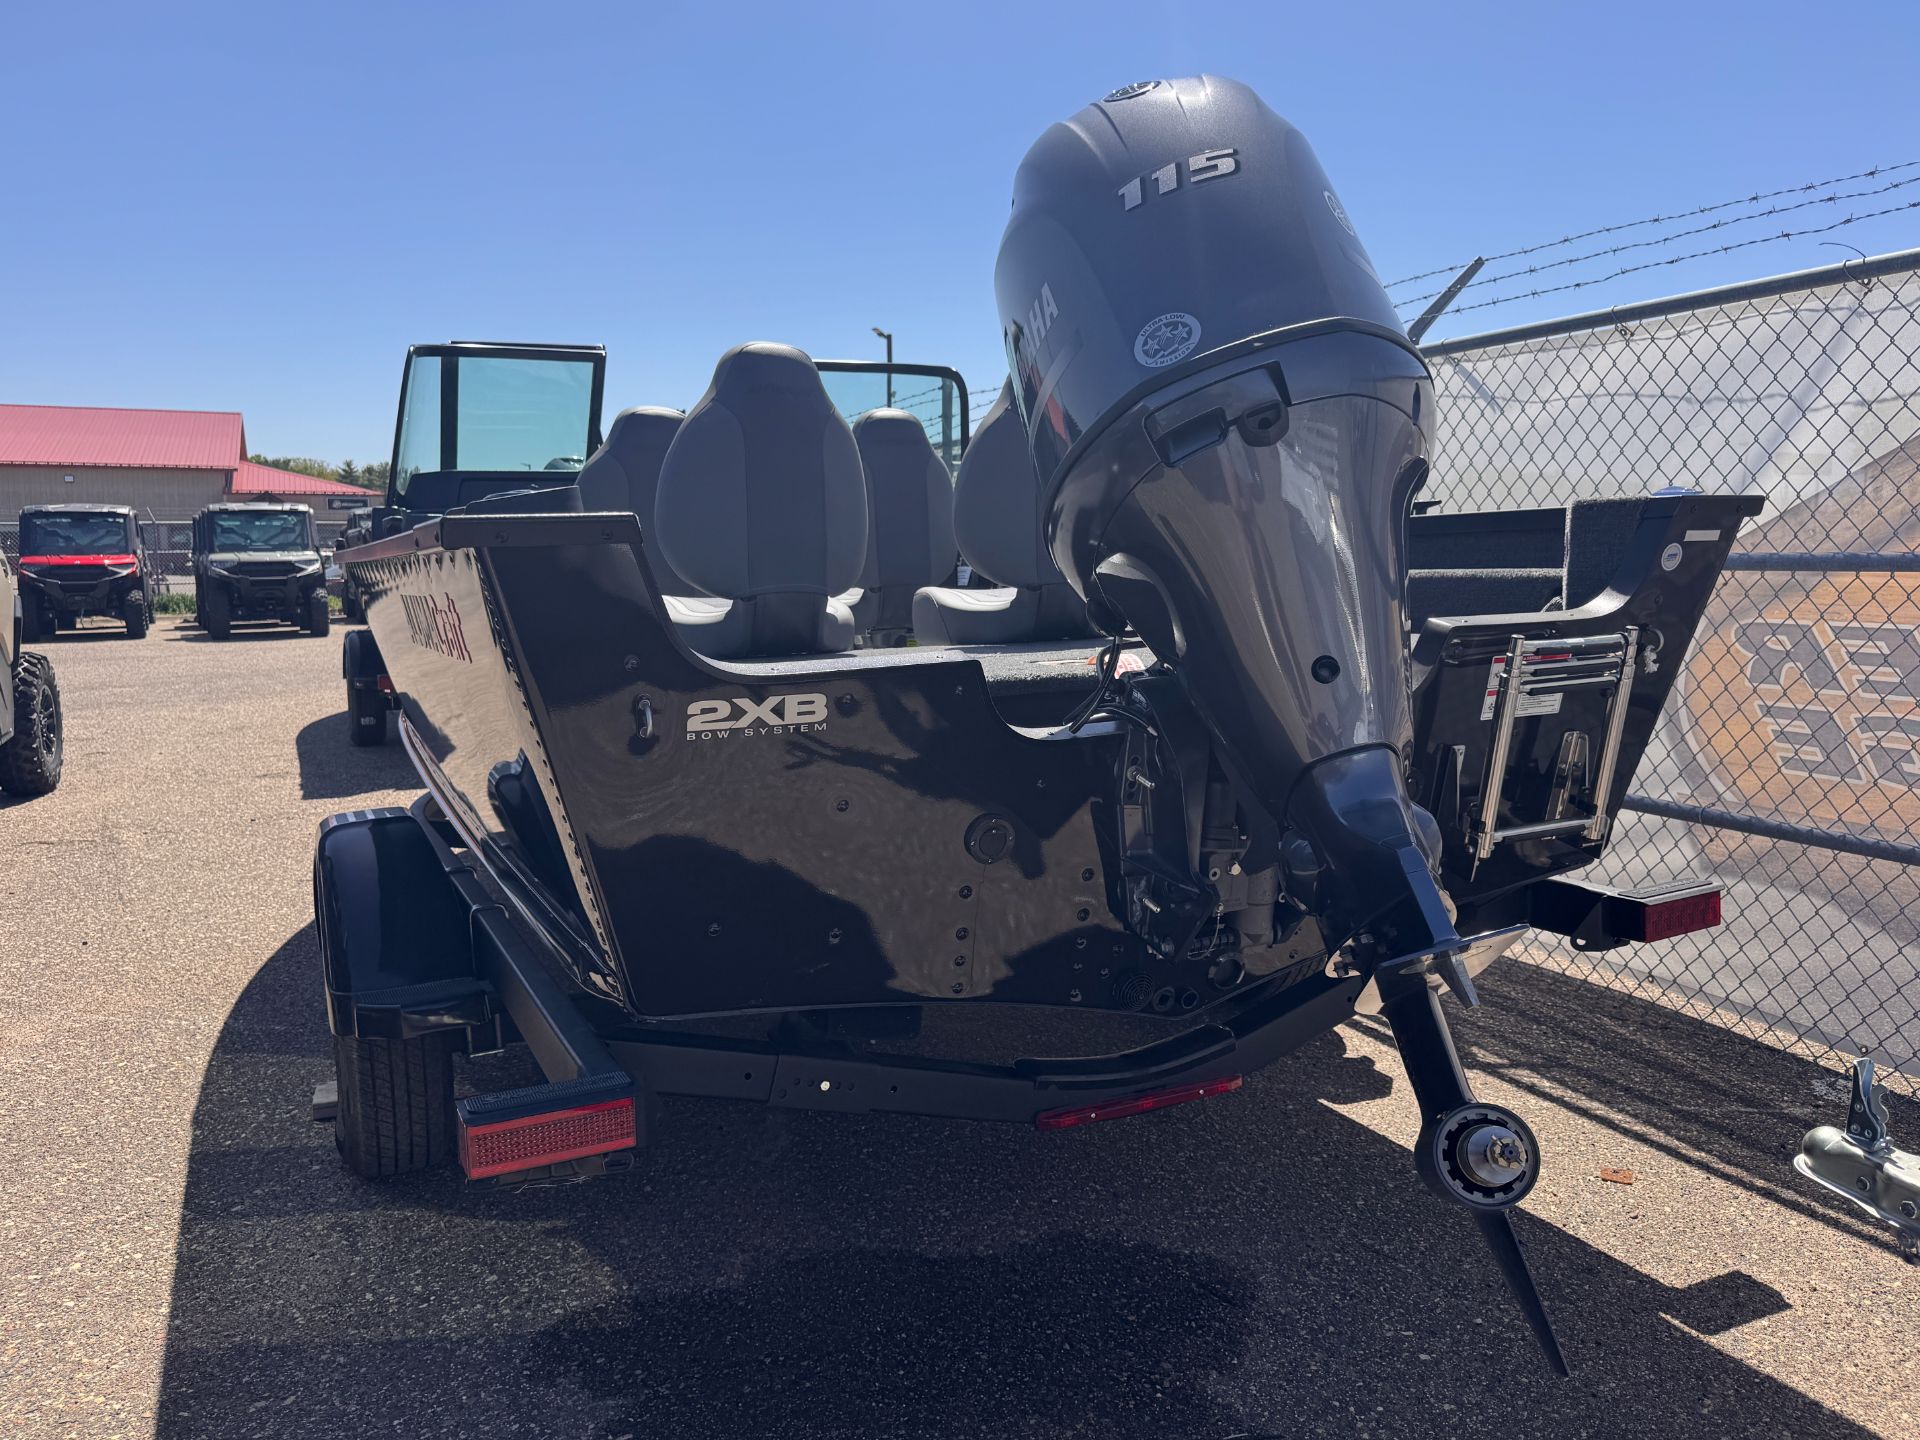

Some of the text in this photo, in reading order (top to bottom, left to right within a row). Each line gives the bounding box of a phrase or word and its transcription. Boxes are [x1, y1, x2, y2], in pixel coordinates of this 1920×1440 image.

[1117, 148, 1237, 211] 115
[1165, 313, 1185, 321] LOW
[686, 692, 828, 731] 2XB
[686, 722, 827, 741] BOW SYSTEM
